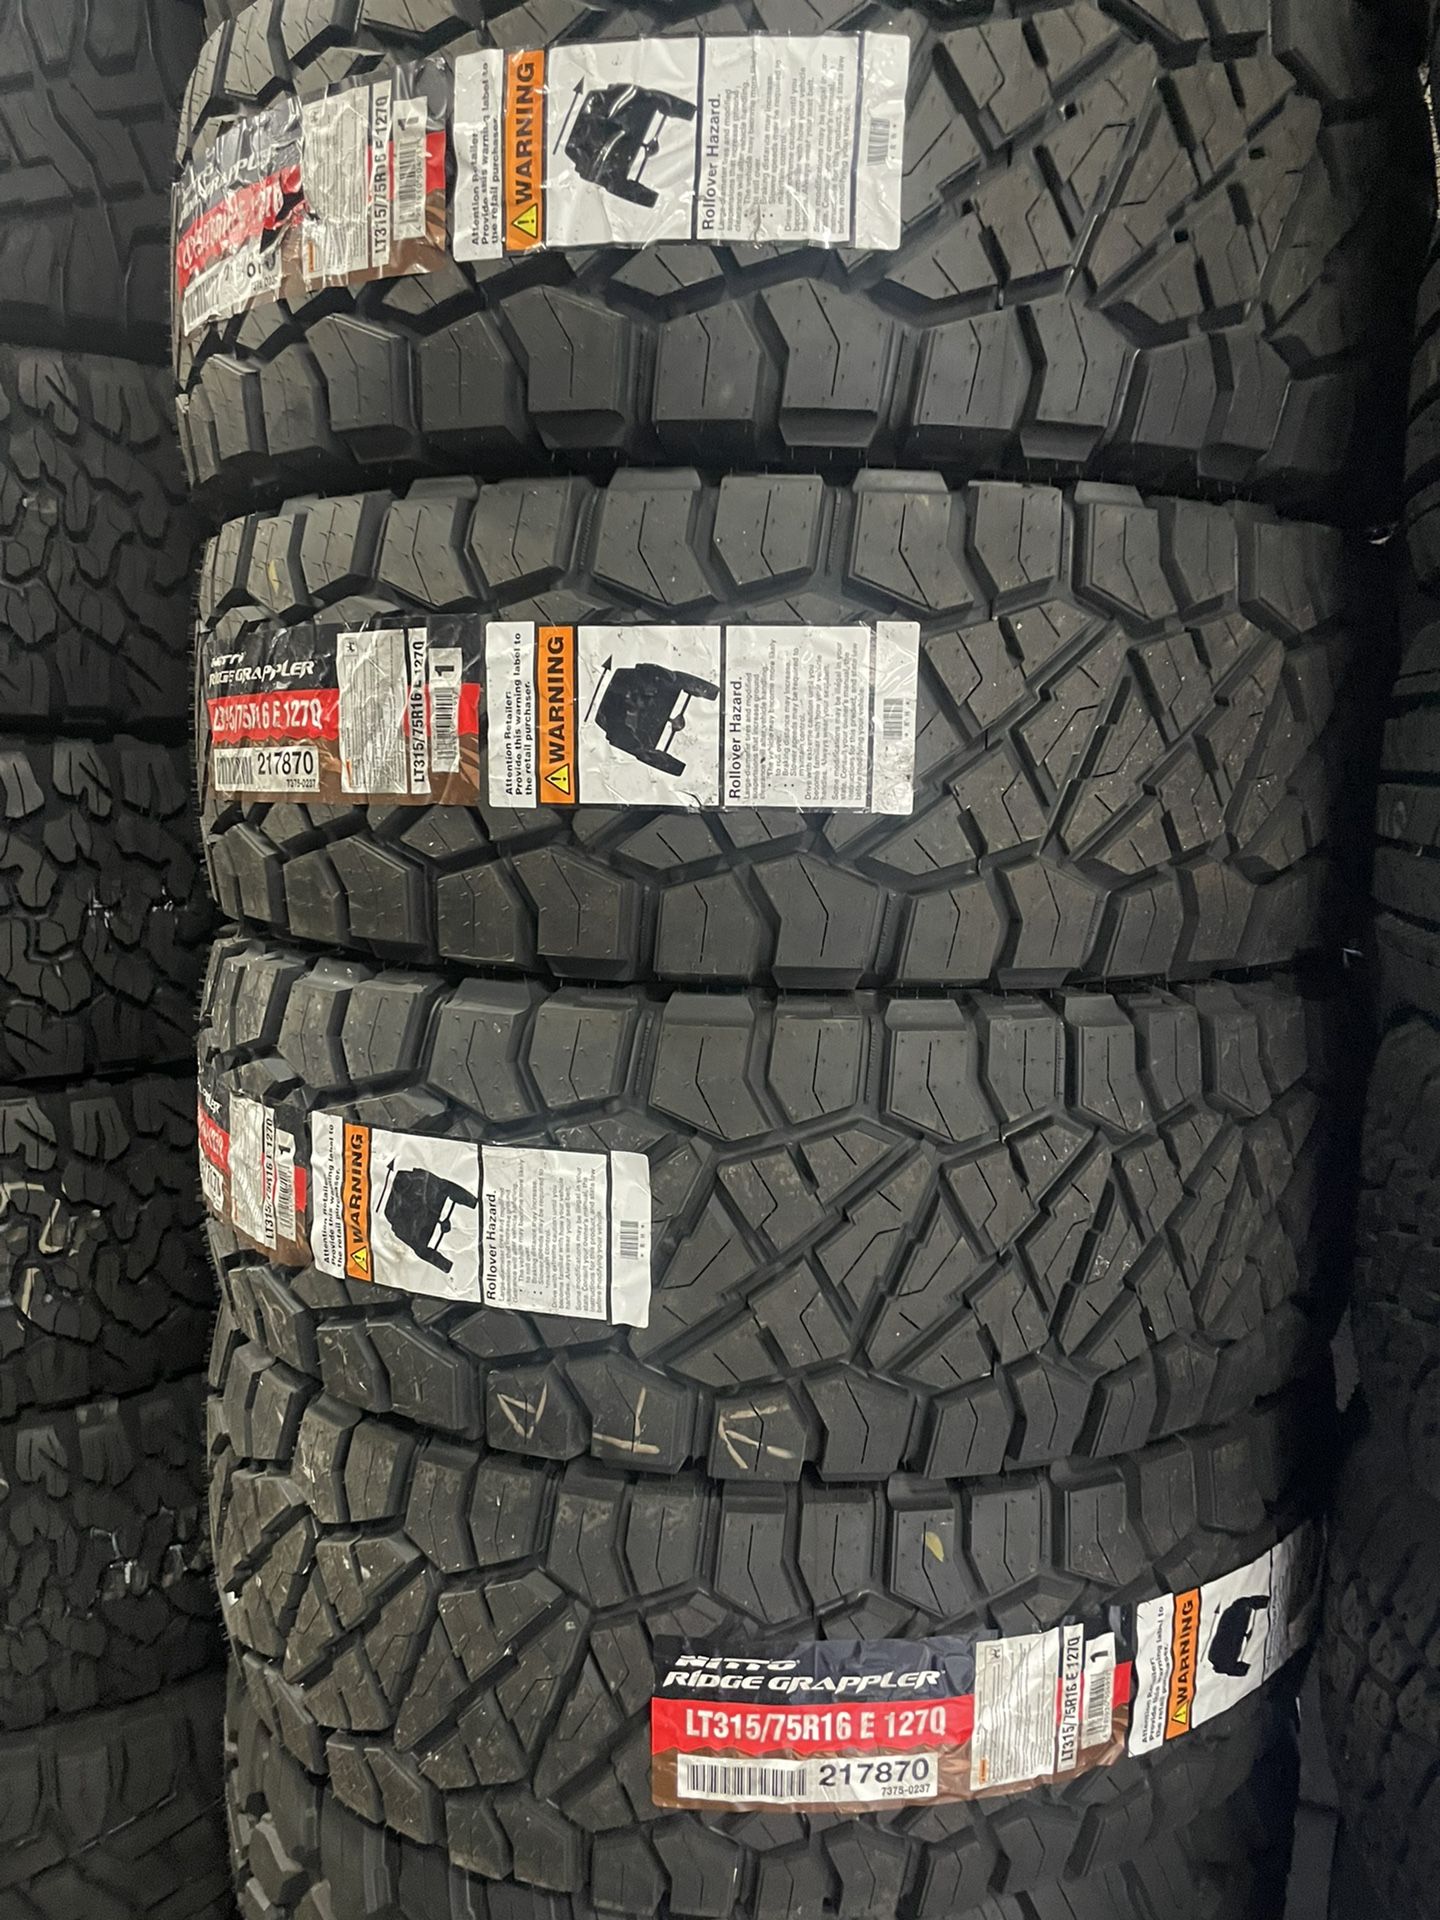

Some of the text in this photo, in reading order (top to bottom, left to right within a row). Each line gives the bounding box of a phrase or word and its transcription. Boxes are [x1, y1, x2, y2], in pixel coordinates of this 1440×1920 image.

[482, 62, 490, 76] to
[374, 95, 388, 132] 127Q
[397, 116, 420, 132] 1
[515, 62, 535, 205] WARNING
[702, 94, 720, 230] Rollover Hazard.
[471, 186, 480, 245] Attention
[482, 197, 490, 244] Provide
[490, 186, 498, 219] retail
[412, 641, 425, 674] 127Q
[514, 633, 520, 645] to
[235, 660, 315, 684] GRAPPLER
[434, 665, 454, 677] 1
[284, 698, 323, 730] 127Q
[514, 680, 522, 725] warning
[547, 636, 565, 764] WARNING
[410, 693, 425, 783] LT315/75R16
[504, 691, 513, 795] Attention Retailer:
[514, 729, 522, 749] this
[524, 681, 533, 795] the retail purchaser.
[729, 676, 742, 799] Rollover Hazard.
[258, 751, 314, 775] 217870
[514, 754, 522, 795] Provide
[328, 1124, 334, 1134] to
[278, 1144, 290, 1156] 1
[350, 1134, 363, 1243] WARNING
[322, 1218, 330, 1263] Attention
[328, 1230, 336, 1265] Provide
[486, 1190, 498, 1300] Rollover Hazard.
[674, 1654, 800, 1672] NITTO
[1090, 1650, 1108, 1662] 1
[1176, 1600, 1194, 1705] WARNING
[663, 1670, 944, 1695] RIDGE GRAPPLER
[1060, 1636, 1081, 1761] LT315/75R16 E 127Q
[686, 1705, 946, 1744] LT315/75R16 E 127Q
[819, 1757, 930, 1787] 217870
